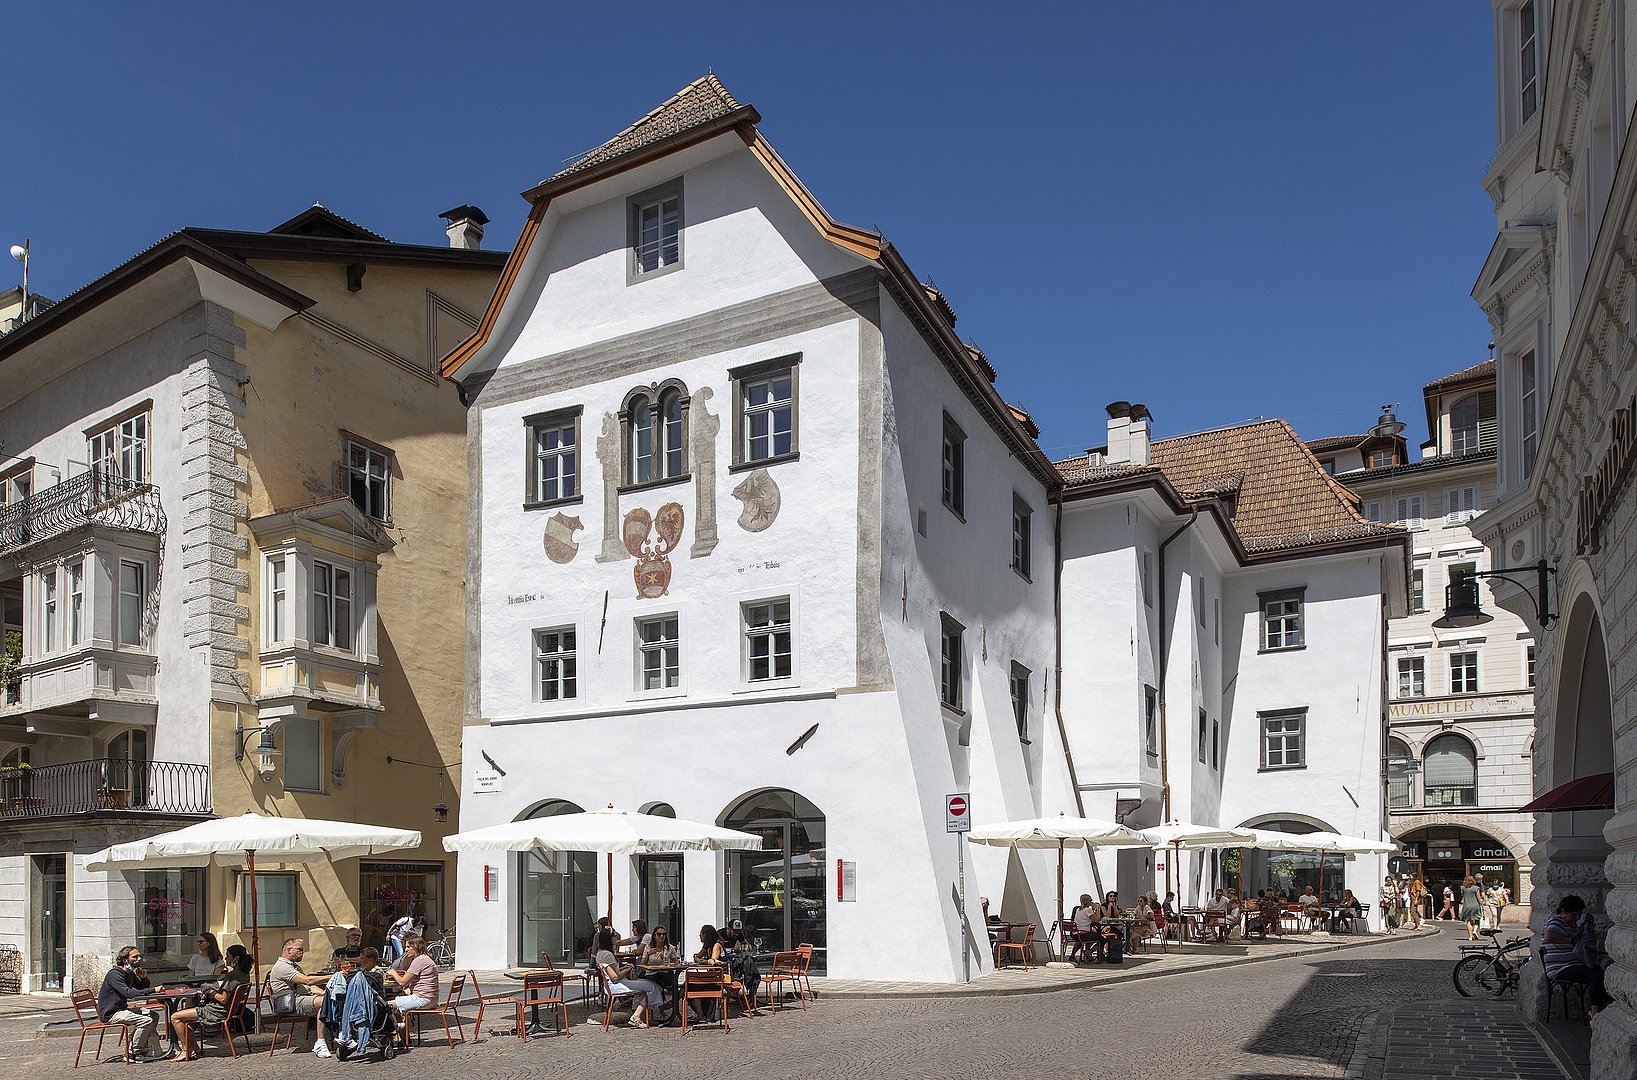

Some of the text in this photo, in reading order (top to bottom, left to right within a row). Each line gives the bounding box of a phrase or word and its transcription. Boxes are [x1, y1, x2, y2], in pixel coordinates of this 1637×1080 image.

[1389, 701, 1474, 717] MUMELTER
[1473, 847, 1509, 857] dmail
[149, 897, 189, 910] SALE
